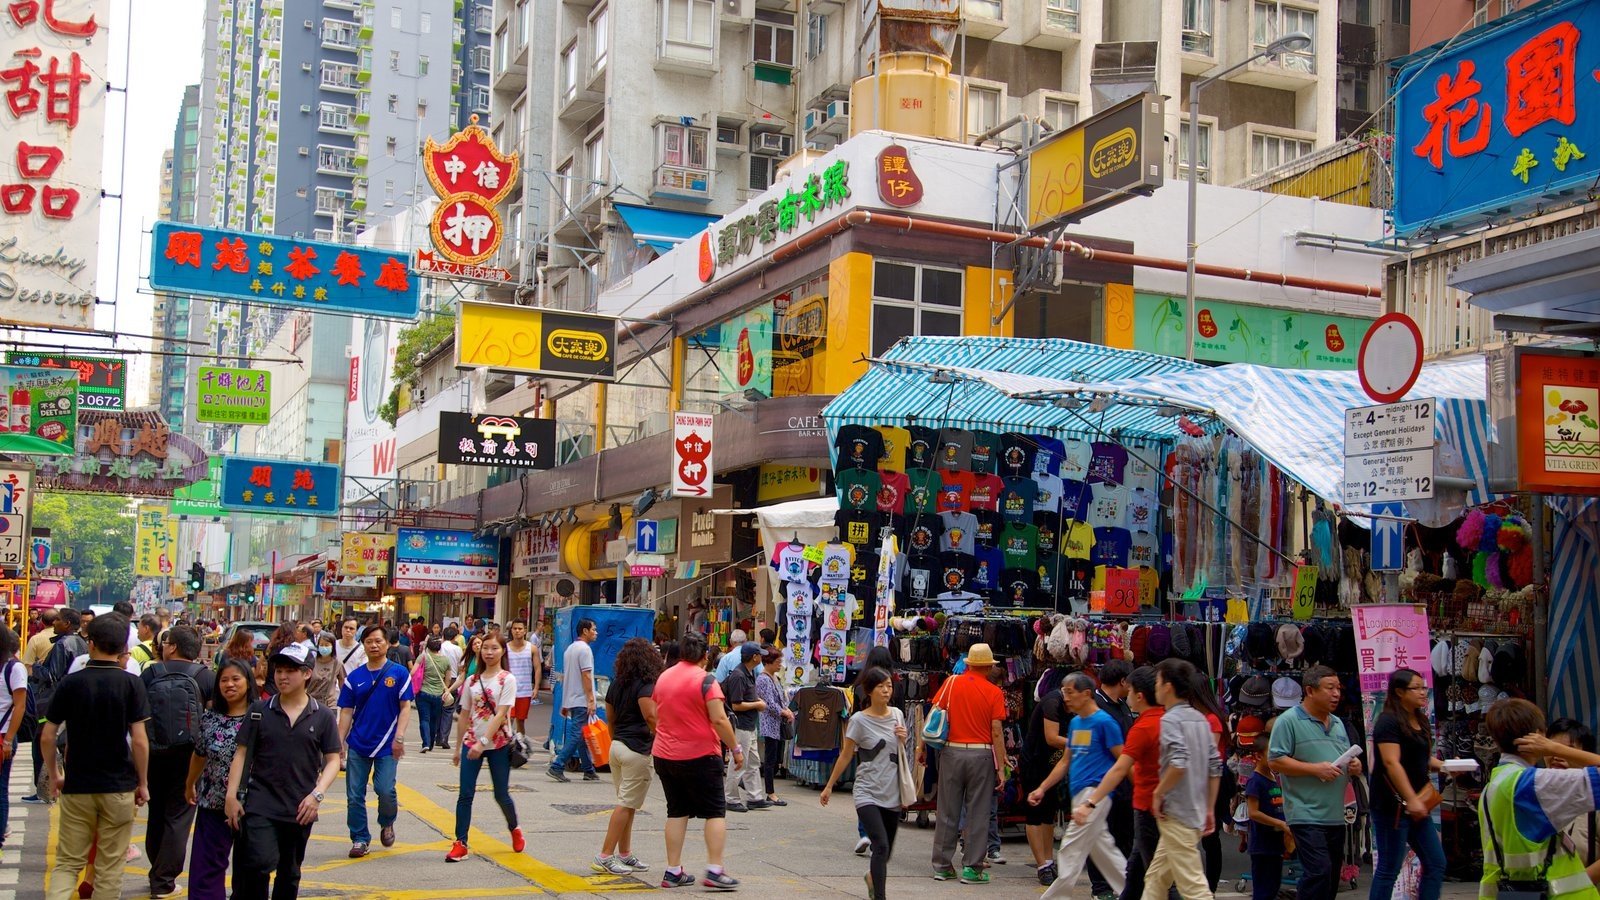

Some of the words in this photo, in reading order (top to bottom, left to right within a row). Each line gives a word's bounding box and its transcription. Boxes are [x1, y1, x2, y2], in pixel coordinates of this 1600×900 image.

[443, 154, 500, 189] 中信
[883, 155, 914, 197] 譚仔
[443, 202, 493, 255] 押
[0, 236, 87, 279] Lucky
[0, 272, 95, 306] Dessert
[1194, 341, 1227, 351] 仔雲南米線
[87, 395, 121, 407] 0672
[40, 409, 58, 417] DEET
[1385, 403, 1412, 413] midnight
[1414, 403, 1430, 419] 12
[1350, 421, 1363, 430] 下午
[1391, 414, 1406, 424] 午夜
[1353, 431, 1373, 439] Except
[1374, 428, 1397, 437] General
[1398, 425, 1425, 434] Holidays
[683, 441, 703, 453] 中信
[1363, 437, 1413, 450] 公眾假期例外
[1363, 458, 1385, 466] General
[1386, 455, 1413, 464] Holidays
[1546, 458, 1567, 469] VITA
[1568, 460, 1599, 471] GREEN
[683, 460, 702, 480] 押
[1371, 466, 1404, 478] 公眾假期
[1385, 477, 1413, 486] midnight
[1415, 476, 1431, 493] 12
[1346, 491, 1360, 499] 中午
[1392, 488, 1407, 496] 午夜
[692, 512, 714, 532] Pixel
[852, 523, 865, 537] 拼
[691, 531, 714, 547] Mobile
[1069, 580, 1084, 590] HK
[1361, 646, 1427, 672] 買一送一
